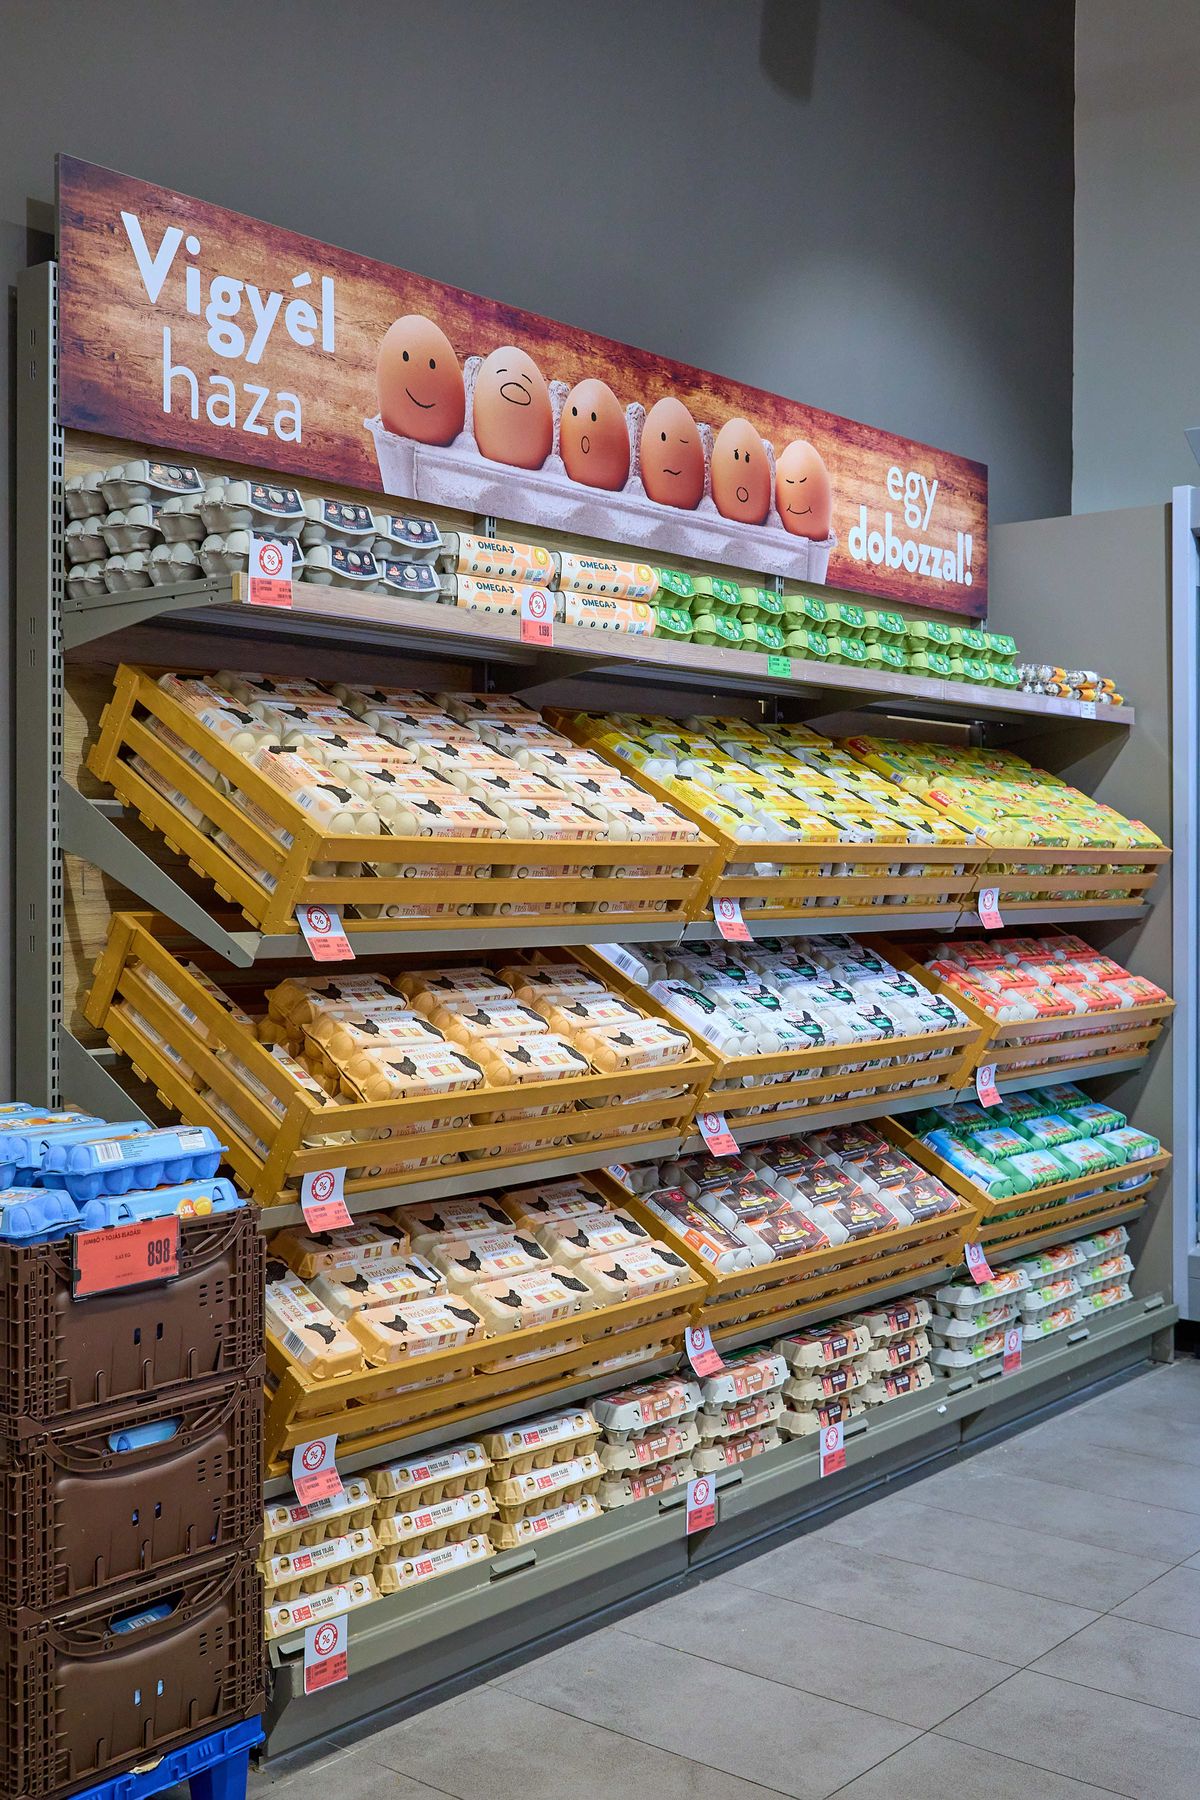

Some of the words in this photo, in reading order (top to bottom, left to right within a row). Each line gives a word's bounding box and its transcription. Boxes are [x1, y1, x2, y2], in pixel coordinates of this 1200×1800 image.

[120, 211, 335, 365] Vigyél
[163, 327, 302, 443] haza
[886, 466, 938, 531] egy
[477, 541, 515, 554] OMEGA-3
[848, 505, 973, 586] dobozzal!
[579, 560, 618, 572] OMEGA-3
[476, 581, 515, 594] OMEGA-3
[581, 598, 617, 609] OMEGA-3
[147, 1237, 170, 1267] 898
